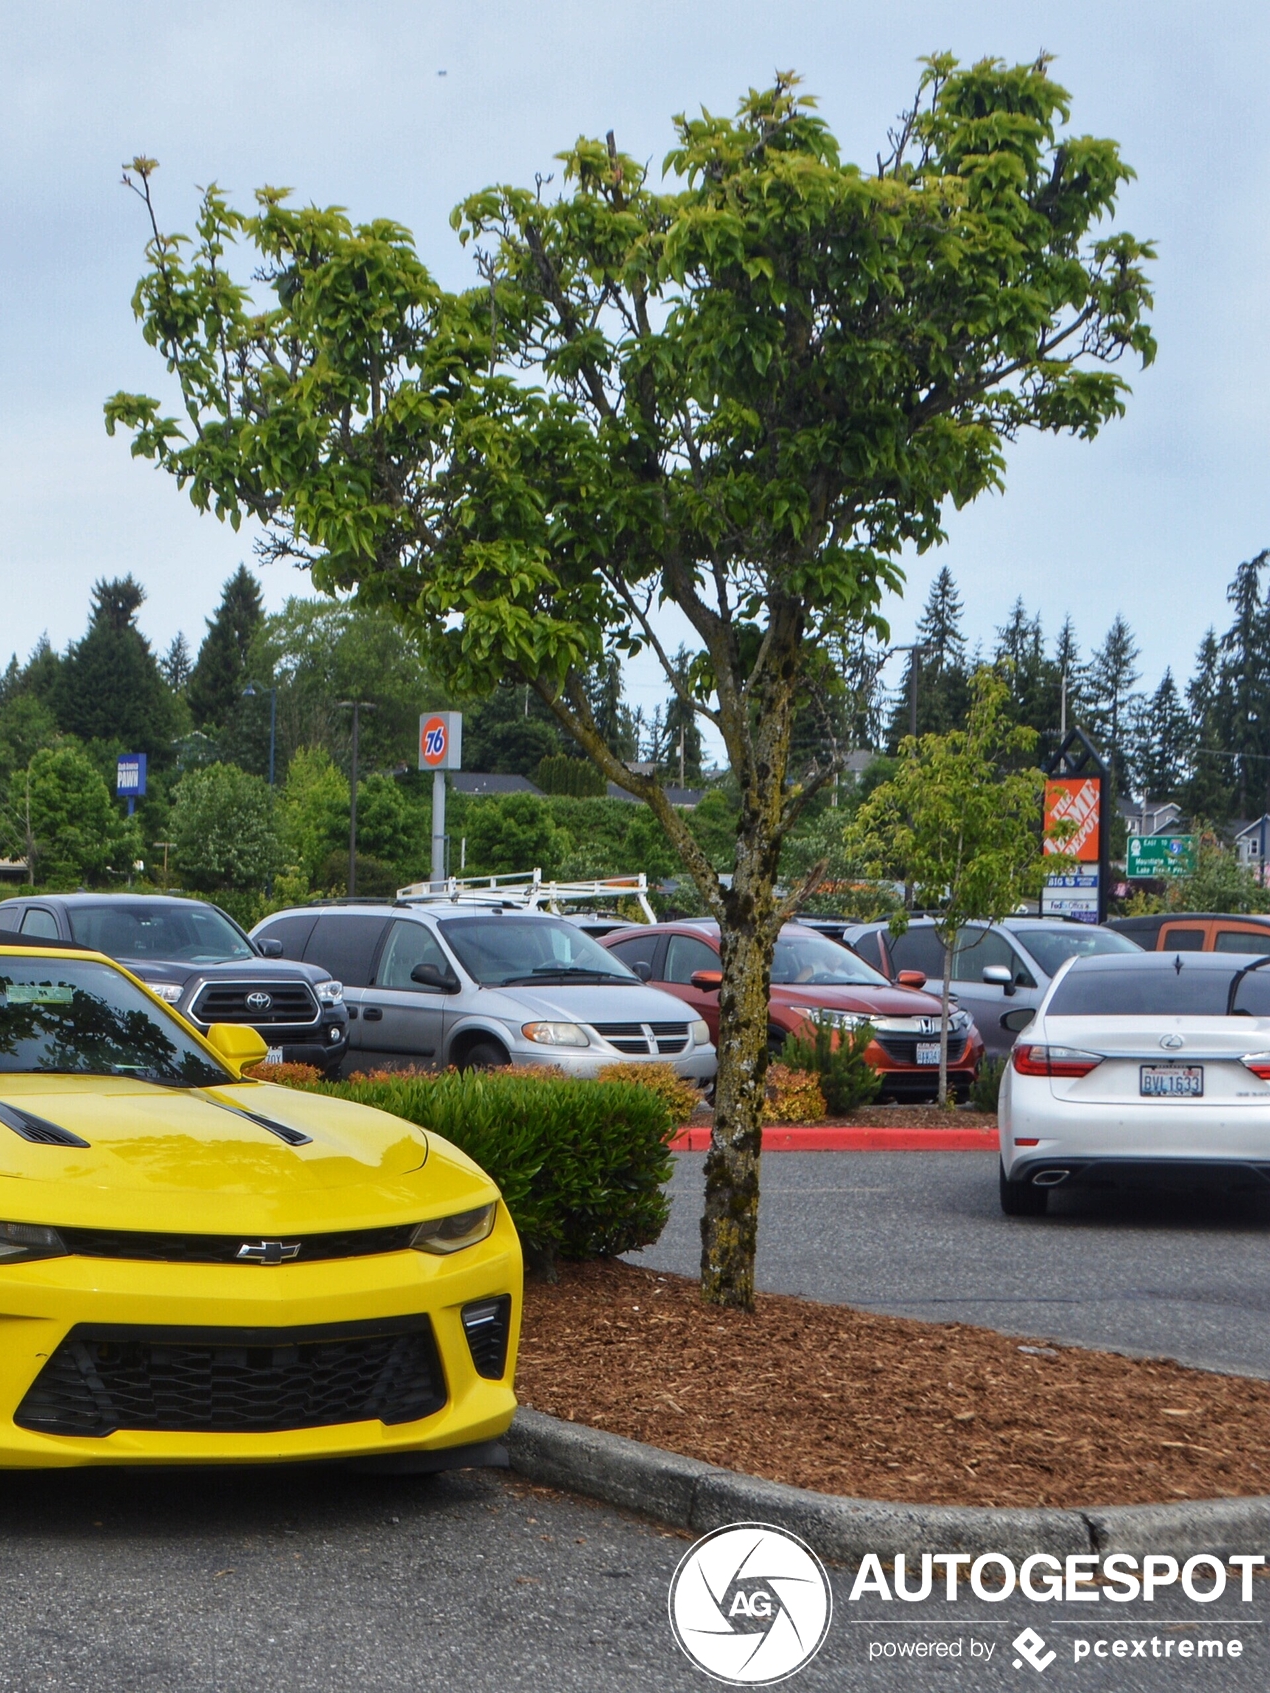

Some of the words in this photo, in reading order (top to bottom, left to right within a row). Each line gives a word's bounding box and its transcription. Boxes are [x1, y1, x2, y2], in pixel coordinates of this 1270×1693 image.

[425, 727, 444, 756] 76
[118, 770, 138, 788] PAWN
[1044, 779, 1100, 853] HME
[1050, 789, 1074, 820] THE
[1064, 808, 1100, 856] DEPOT
[1173, 843, 1179, 854] 5
[1048, 877, 1063, 886] BIG
[1144, 1076, 1199, 1092] BVL1633
